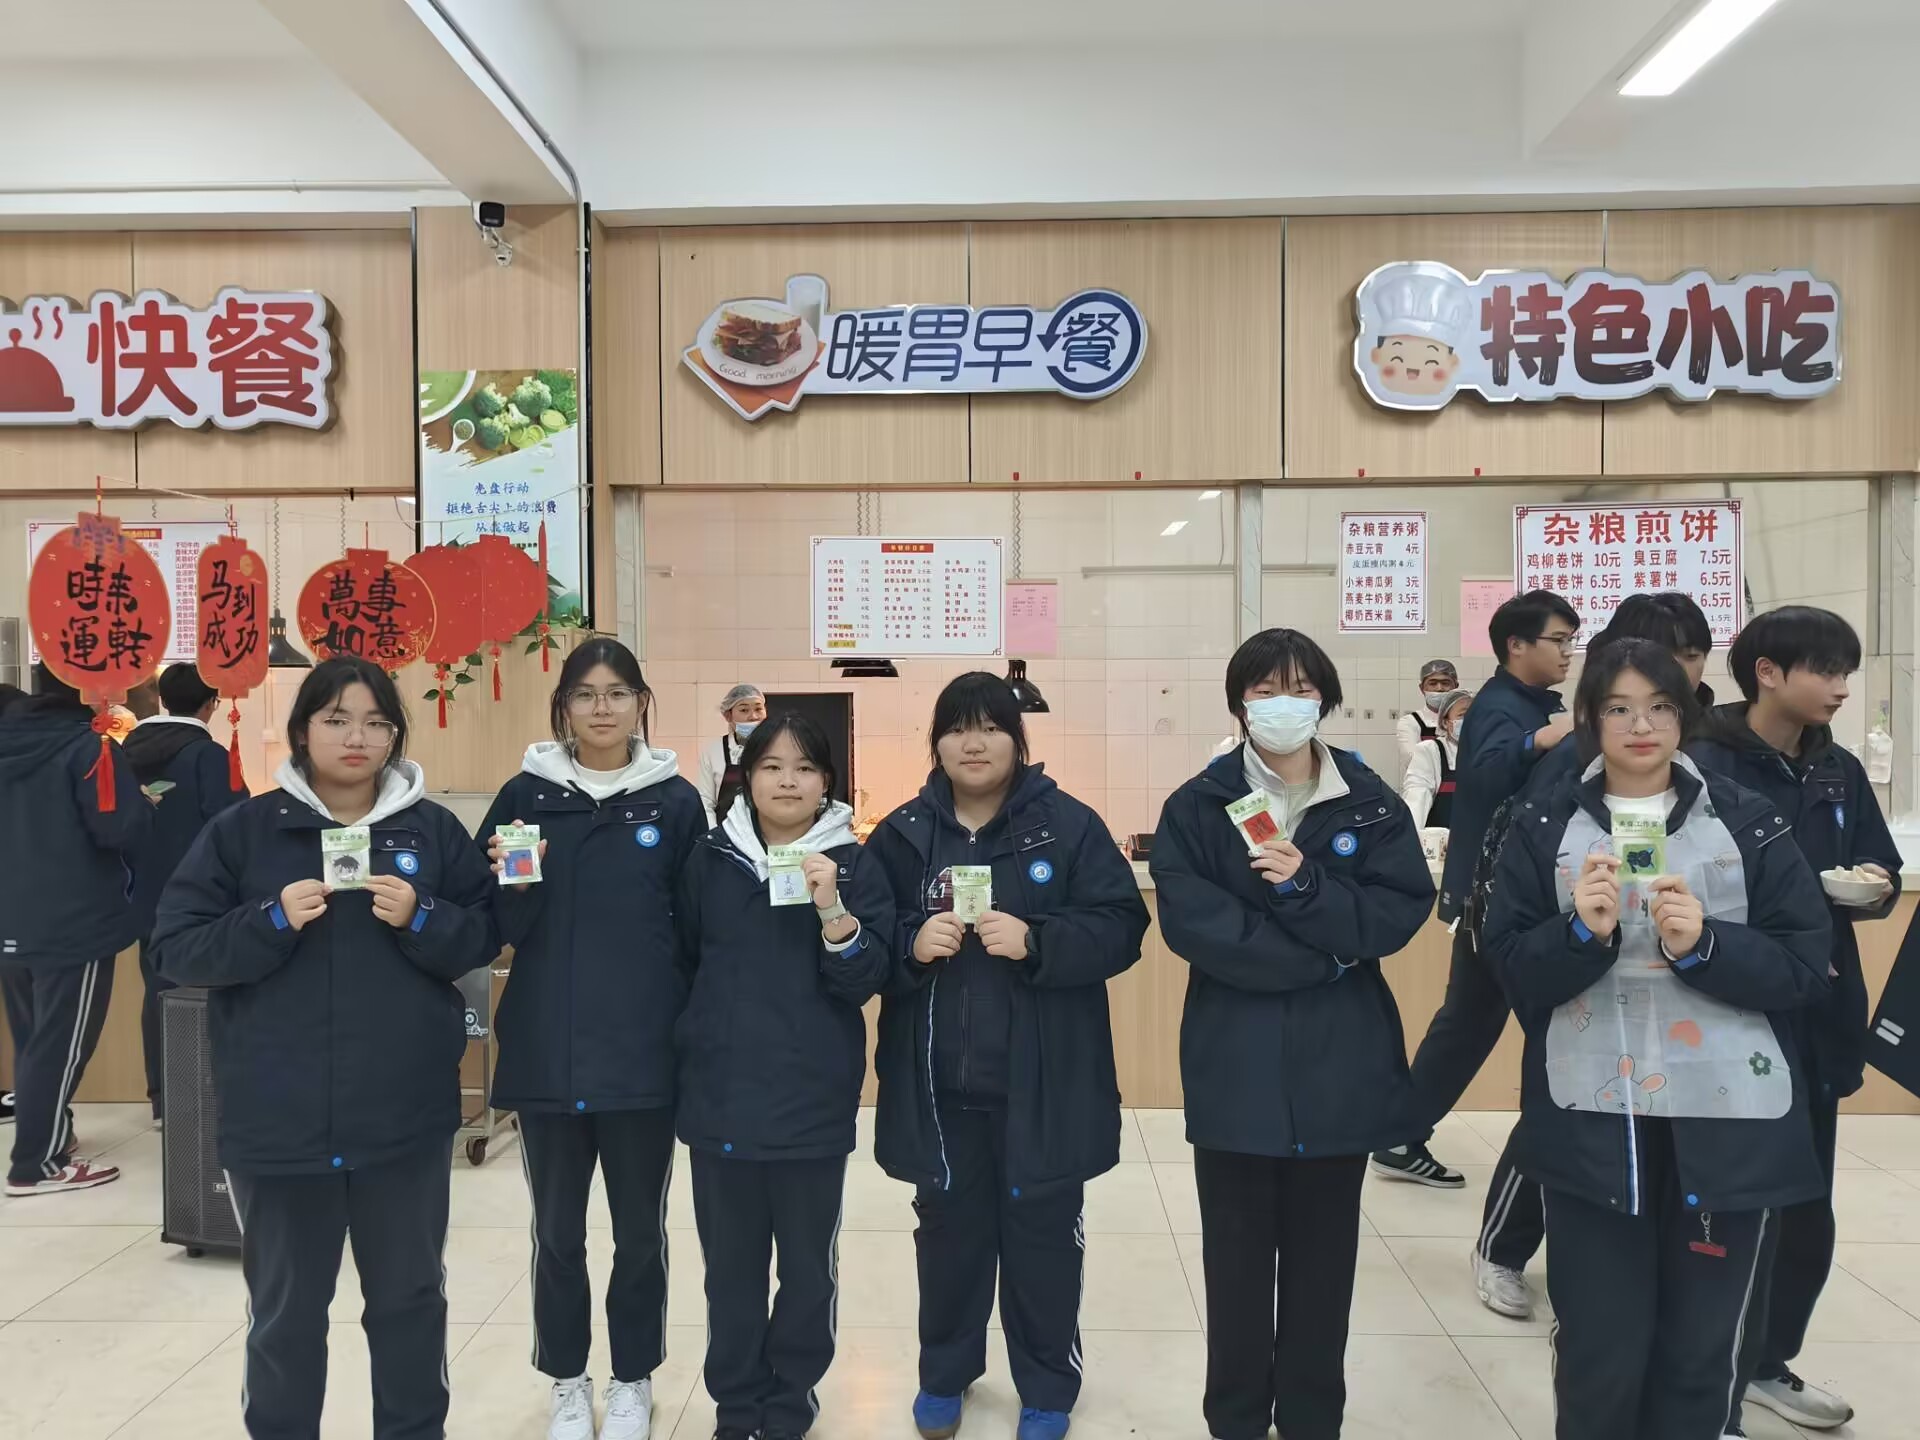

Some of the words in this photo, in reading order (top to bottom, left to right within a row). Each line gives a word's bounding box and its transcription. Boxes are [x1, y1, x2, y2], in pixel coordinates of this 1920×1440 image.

[1480, 281, 1835, 385] 特色小吃
[827, 310, 1121, 382] 暖胃早餐
[87, 297, 319, 417] 快餐
[719, 364, 747, 377] Good
[475, 482, 529, 495] 光盘行动
[446, 501, 557, 514] 拒绝舌尖上的浪费
[1348, 522, 1419, 536] 杂粮营养粥
[1544, 509, 1718, 546] 杂粮煎饼
[1405, 543, 1419, 555] 4元
[1527, 552, 1583, 569] 鸡柳卷饼
[1594, 552, 1621, 568] 10元
[1634, 549, 1677, 566] 臭豆腐
[1700, 549, 1731, 565] 7.5元
[1346, 576, 1392, 588] 小米南瓜粥
[1406, 576, 1419, 588] 3元
[1527, 573, 1583, 590] 鸡蛋卷饼
[1590, 573, 1622, 589] 6.5元
[1634, 571, 1677, 588] 紫薯饼
[1700, 571, 1731, 586] 6.5元
[1346, 592, 1392, 604] 燕麦牛奶粥
[1398, 592, 1419, 604] 3.5元
[1590, 594, 1622, 610] 6.5元
[1700, 592, 1732, 608] 6.5元
[1345, 609, 1392, 621] 椰奶西米露
[1405, 609, 1419, 621] 4元
